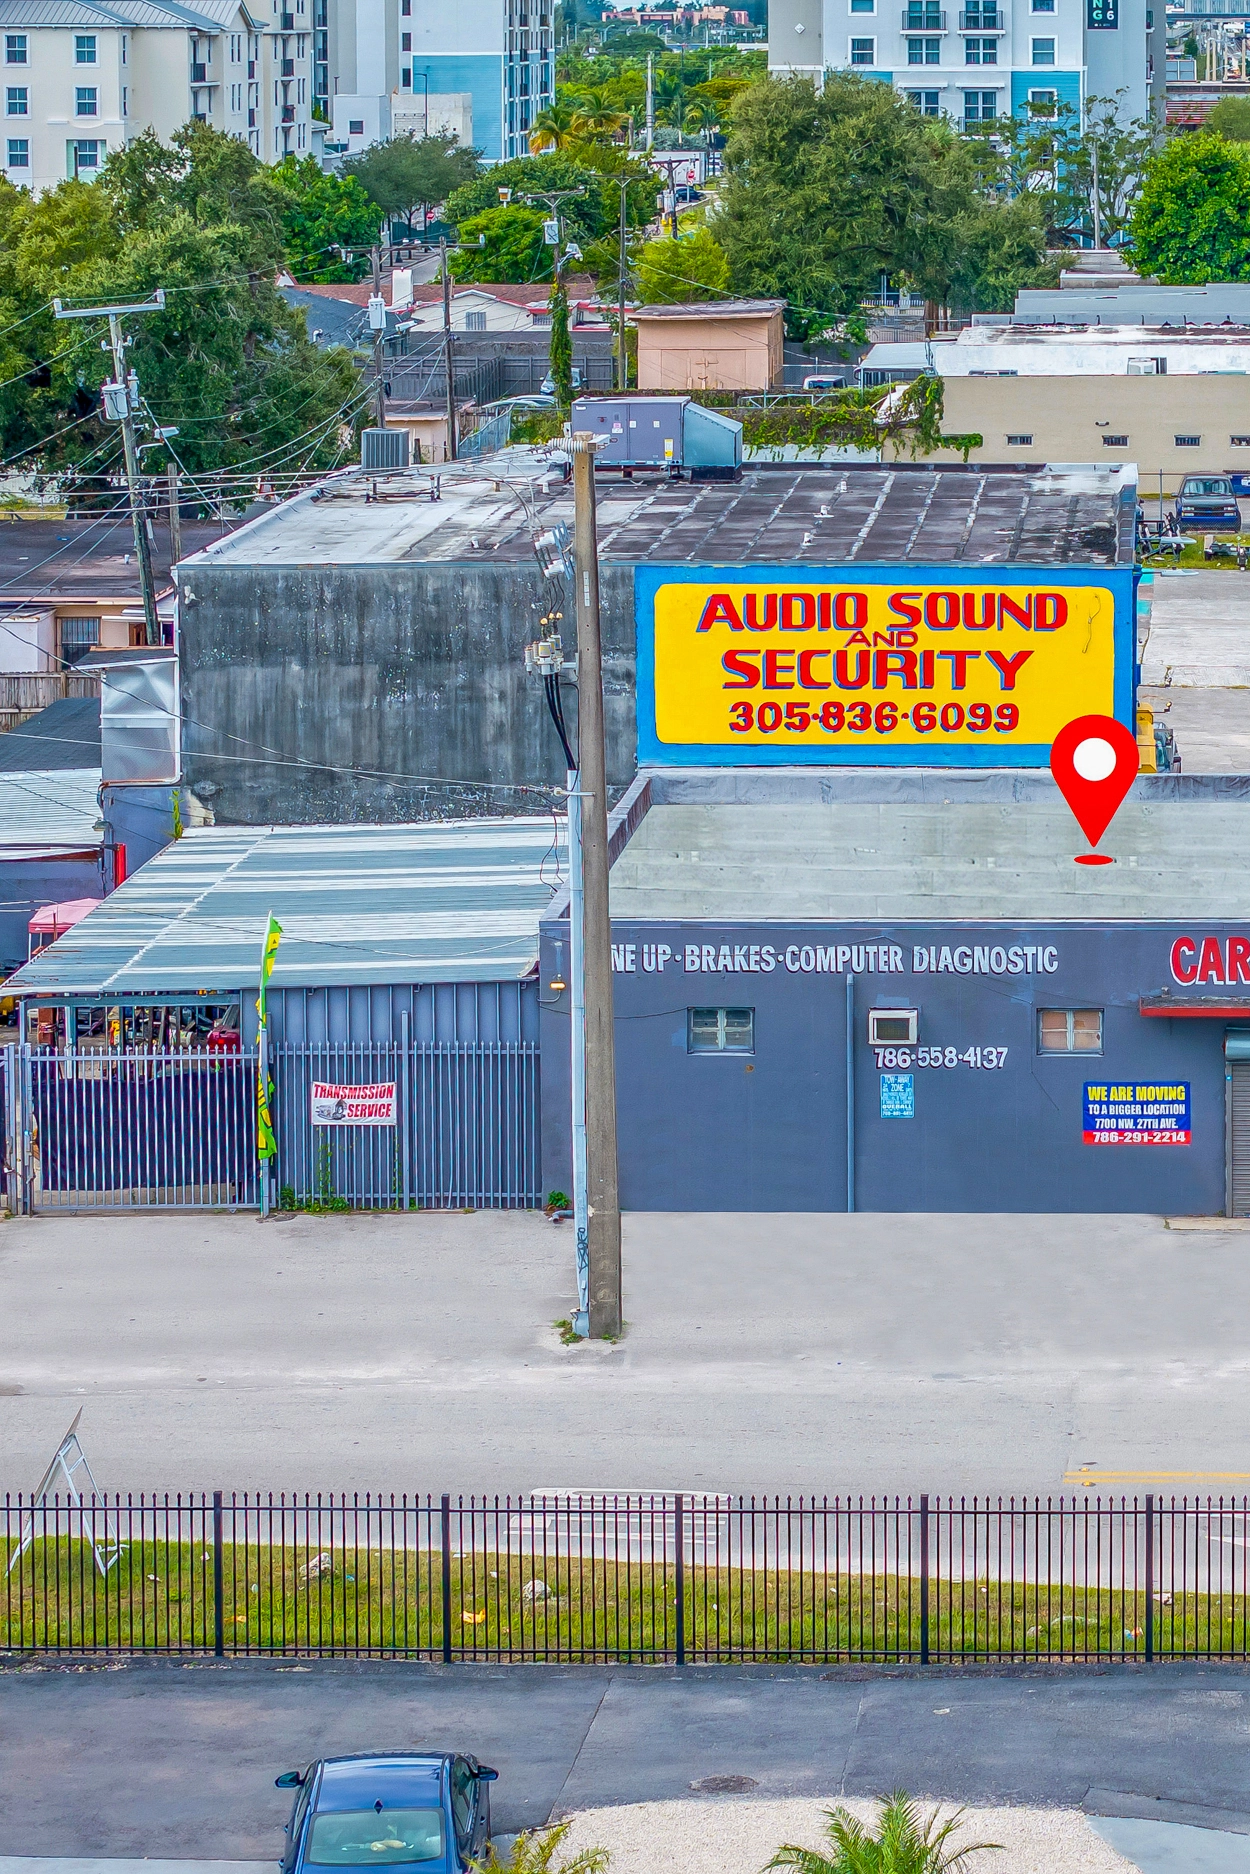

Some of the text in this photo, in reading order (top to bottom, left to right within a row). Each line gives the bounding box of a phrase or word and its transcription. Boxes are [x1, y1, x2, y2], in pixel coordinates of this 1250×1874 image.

[696, 592, 1068, 632] AUDIO SOUND
[843, 630, 919, 649] AND
[721, 649, 1036, 691] SECURITY
[911, 945, 1059, 975] DIAGNOSTIC
[314, 1084, 394, 1099] TRANSMISSION
[891, 1083, 905, 1092] ZONE
[1087, 1085, 1186, 1101] WE ARE MOVING
[347, 1103, 392, 1118] SERVICE
[1088, 1104, 1186, 1115] TO A BIGGER LOCATION
[1094, 1118, 1179, 1129] 7700 NW. 27TH AVE.
[1092, 1131, 1186, 1143] 786-291-2214
